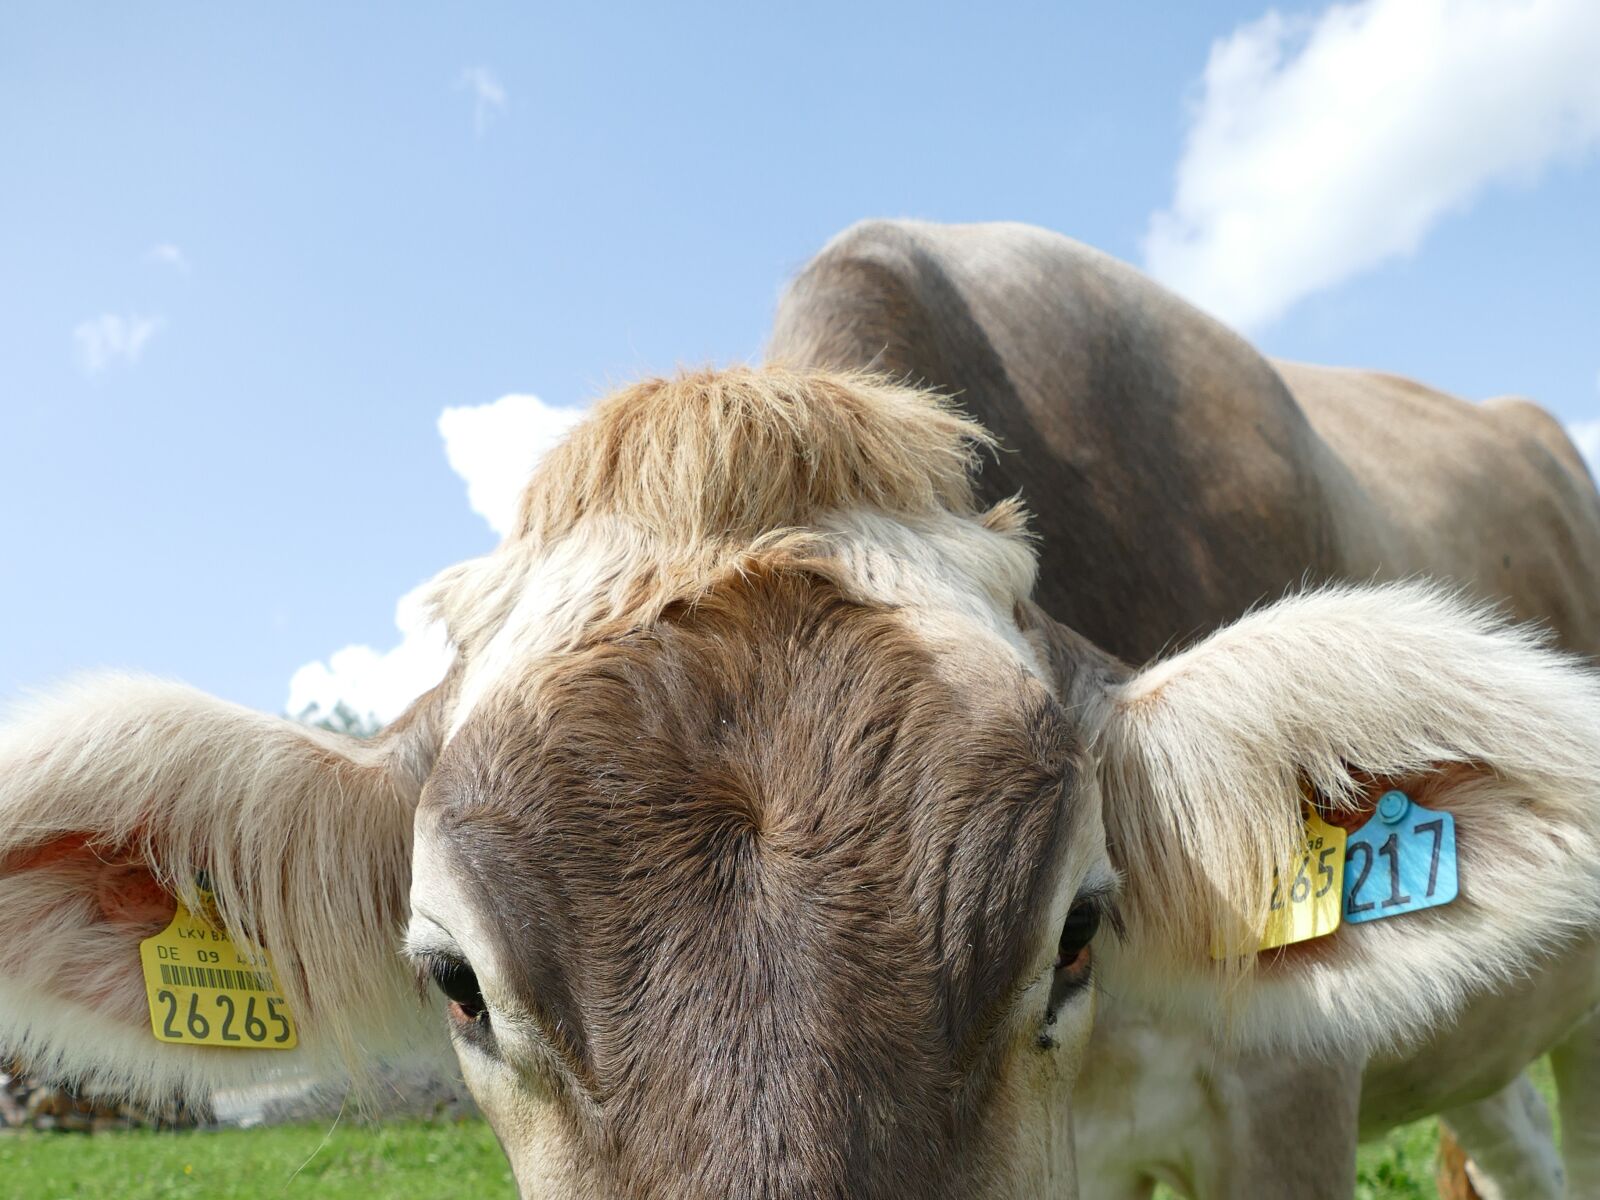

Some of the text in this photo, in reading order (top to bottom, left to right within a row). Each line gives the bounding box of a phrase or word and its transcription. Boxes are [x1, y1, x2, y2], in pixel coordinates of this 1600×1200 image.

[1346, 818, 1444, 915] 217
[178, 927, 205, 940] LKV
[157, 945, 180, 961] DE
[197, 949, 220, 963] 09
[157, 989, 290, 1043] 26265
